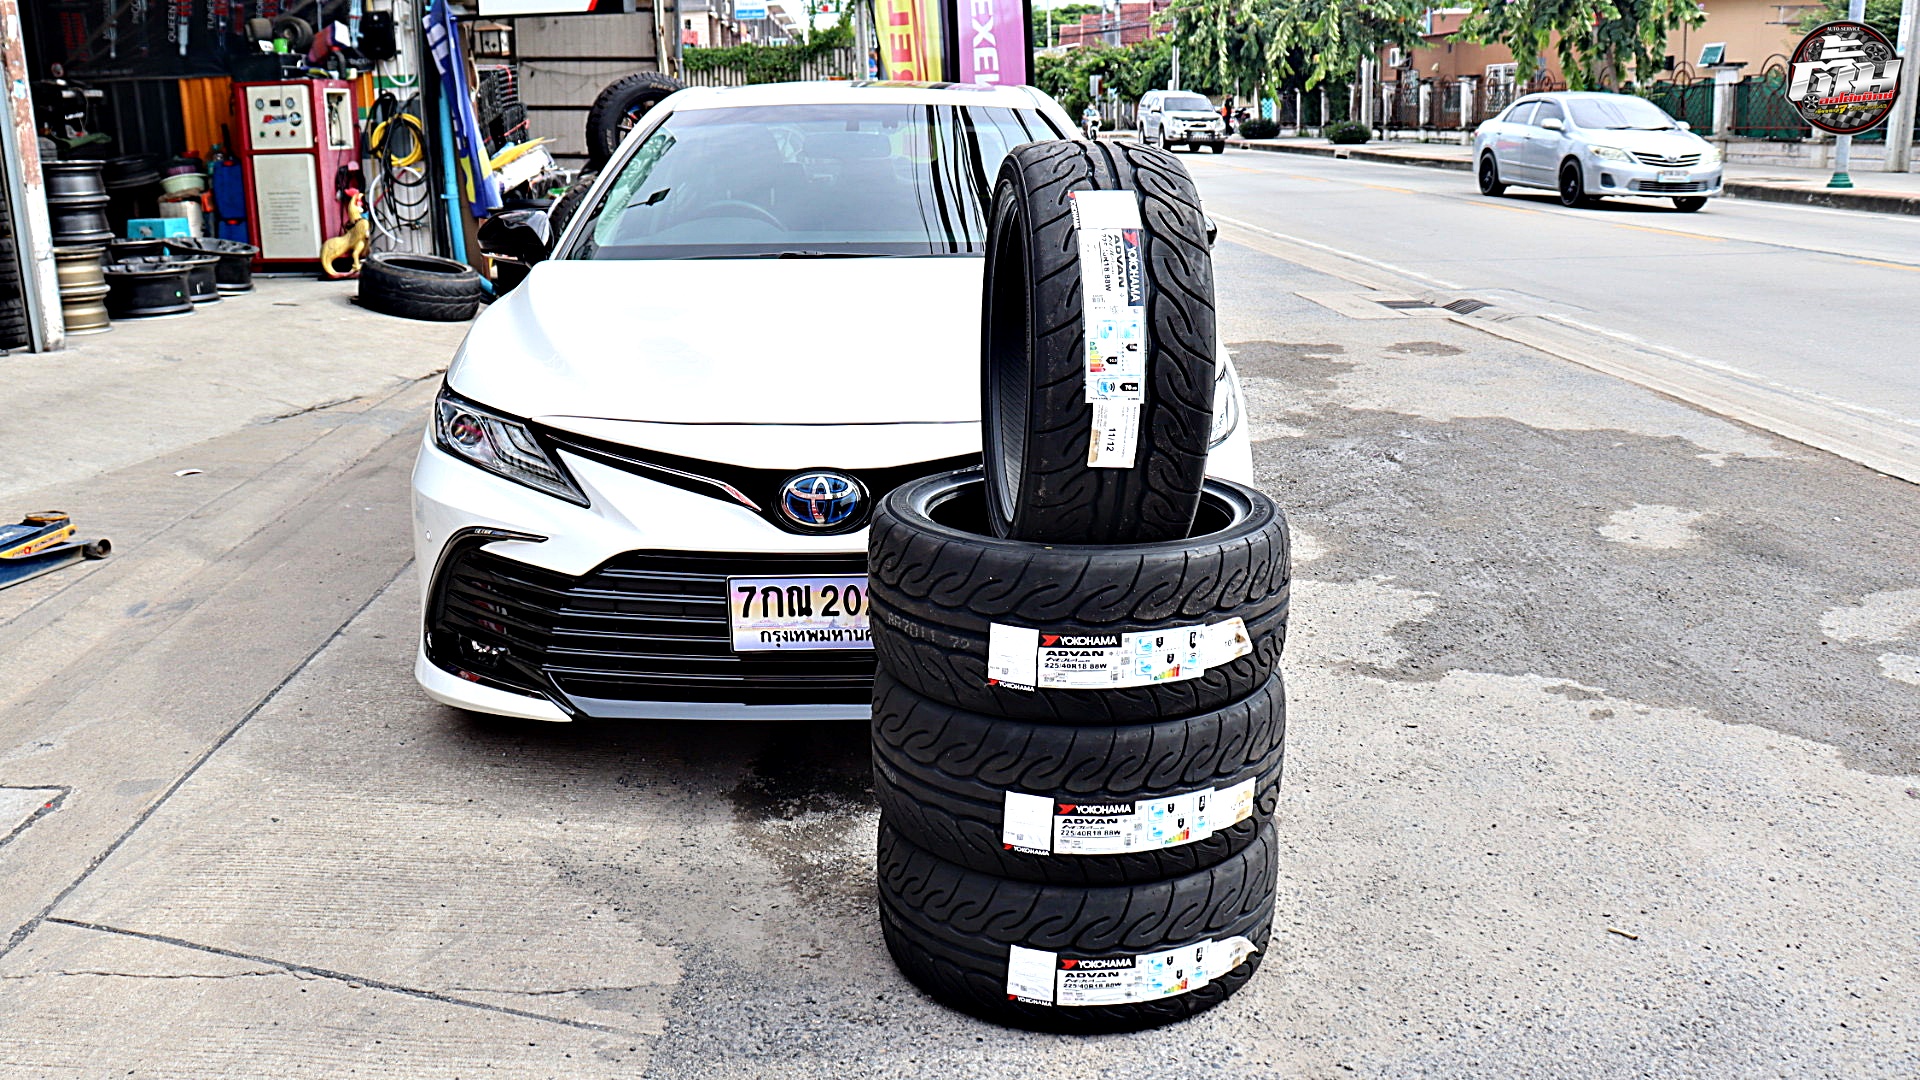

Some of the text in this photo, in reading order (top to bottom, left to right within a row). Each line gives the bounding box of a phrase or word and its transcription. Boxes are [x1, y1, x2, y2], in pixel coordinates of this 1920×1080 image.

[167, 4, 177, 42] QUEEN
[1114, 234, 1125, 288] ADVAN
[1127, 246, 1141, 303] YOKOHAMA
[1106, 428, 1117, 452] 11/12
[821, 584, 869, 617] 20
[760, 629, 873, 648] กรุงเทพมหานค
[1060, 635, 1118, 646] YOKOHAMA
[999, 681, 1035, 692] YOKOHAMA
[1076, 804, 1132, 815] YOKOHAMA
[1013, 846, 1050, 856] YOKOHAMA
[1078, 958, 1133, 969] YOKOHAMA
[1017, 996, 1053, 1007] YOKOHAMA
